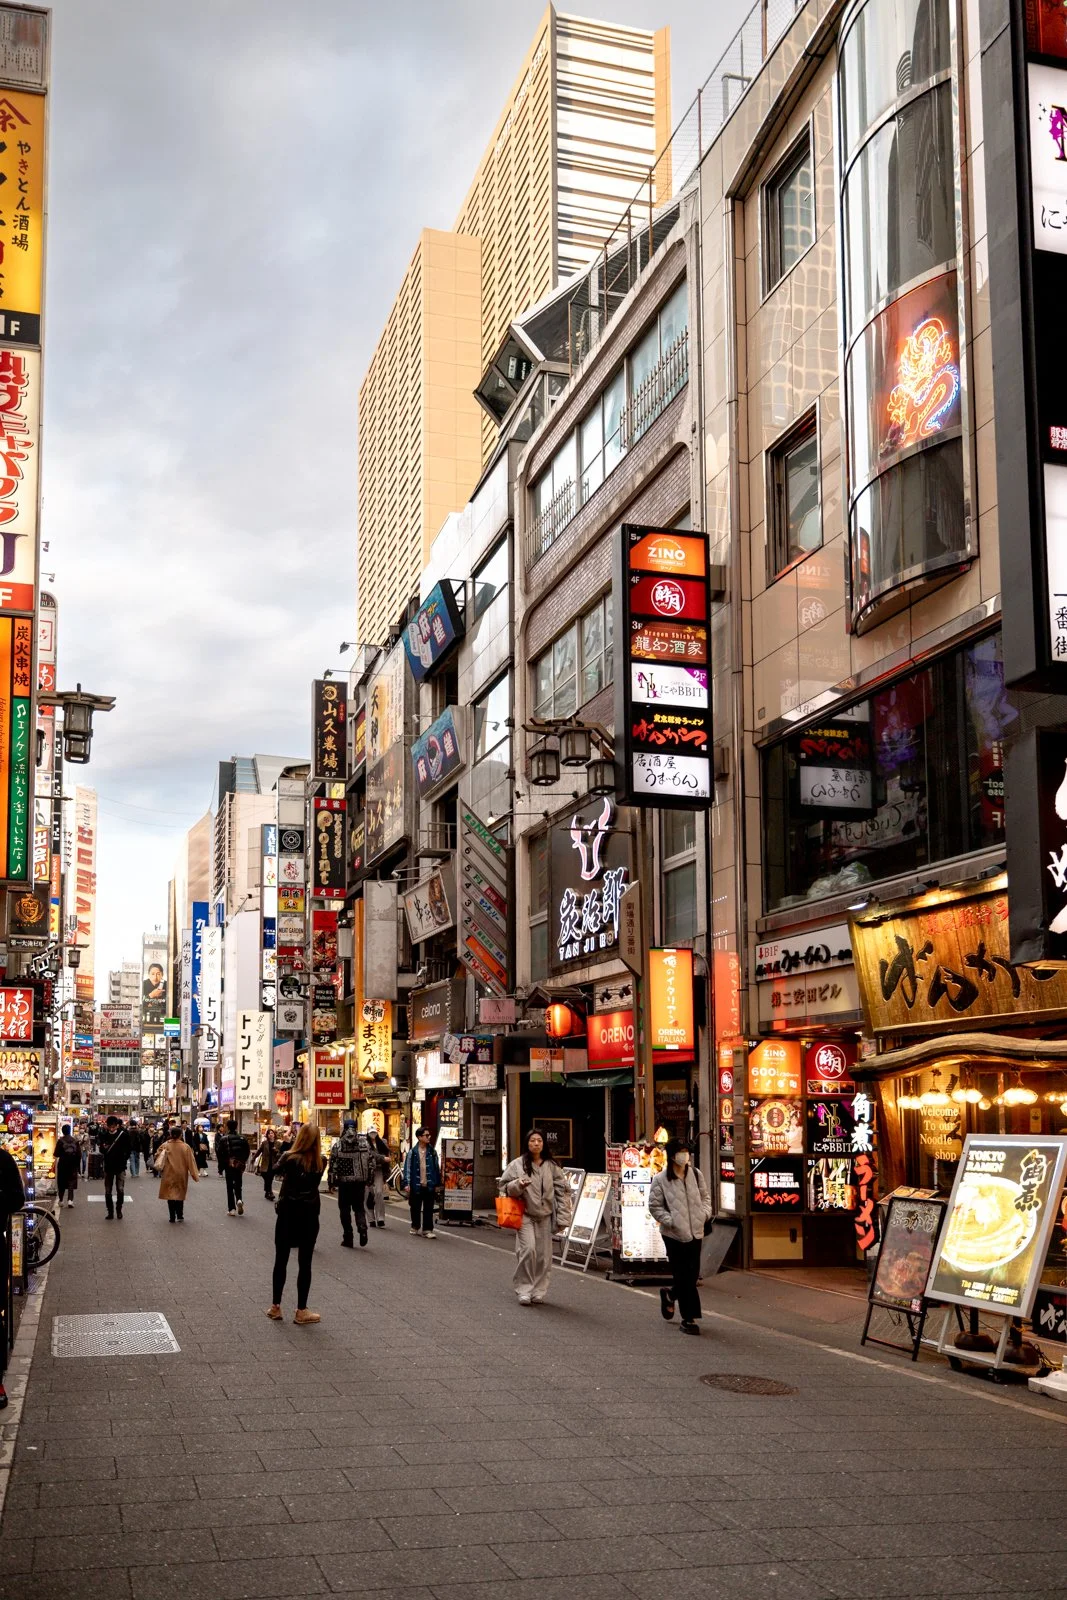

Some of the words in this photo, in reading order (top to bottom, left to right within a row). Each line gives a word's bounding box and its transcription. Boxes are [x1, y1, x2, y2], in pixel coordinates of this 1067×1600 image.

[11, 140, 32, 252] やきとん酒場
[630, 533, 641, 541] 5F
[647, 547, 686, 560] ZINO
[632, 621, 643, 630] 3F
[644, 630, 669, 638] Dragon
[671, 631, 695, 640] Shisha
[635, 635, 703, 655] 龍幻酒家
[14, 626, 30, 687] 炭火串焼
[693, 670, 707, 682] 2F
[653, 713, 704, 727] 東京豚骨ラーメン
[322, 701, 338, 769] 山久農場
[632, 718, 708, 747] ばんから
[635, 753, 677, 770] 居酒屋
[645, 768, 698, 788] うまいもん
[320, 800, 340, 808] 麻雀
[464, 847, 471, 855] 6
[464, 864, 471, 872] 5
[464, 899, 471, 907] 3
[558, 867, 627, 947] 炭治郎
[464, 916, 471, 924] 2
[926, 899, 1009, 936] 東京豚骨ラ
[559, 942, 579, 960] TAN
[583, 937, 594, 954] JI
[599, 931, 614, 948] RO
[879, 934, 1060, 1012] ばんか
[662, 955, 677, 1024] 俺のイタリアン
[771, 983, 842, 1008] 第二安田ビル
[207, 997, 217, 1049] トンン
[600, 1025, 635, 1044] ORENO
[658, 1028, 686, 1036] ORENO
[240, 1014, 251, 1091] トントン
[363, 1023, 377, 1074] まっちゃん
[763, 1049, 787, 1057] ZINO
[317, 1068, 342, 1078] FINE
[751, 1067, 777, 1076] 600
[920, 1106, 959, 1117] Welcome
[924, 1121, 937, 1131] To
[939, 1122, 955, 1131] our
[546, 1132, 558, 1140] KK
[764, 1133, 788, 1143] Dragon
[920, 1134, 953, 1146] Noodle
[764, 1142, 788, 1151] Shisha
[935, 1150, 957, 1162] shop
[968, 1150, 1006, 1162] TOKYO
[966, 1161, 1003, 1173] RAMEN
[624, 1170, 637, 1180] 4F
[1013, 1148, 1047, 1213] 角煮
[754, 1189, 800, 1205] ばんから
[889, 1209, 938, 1233] ぶっかけ
